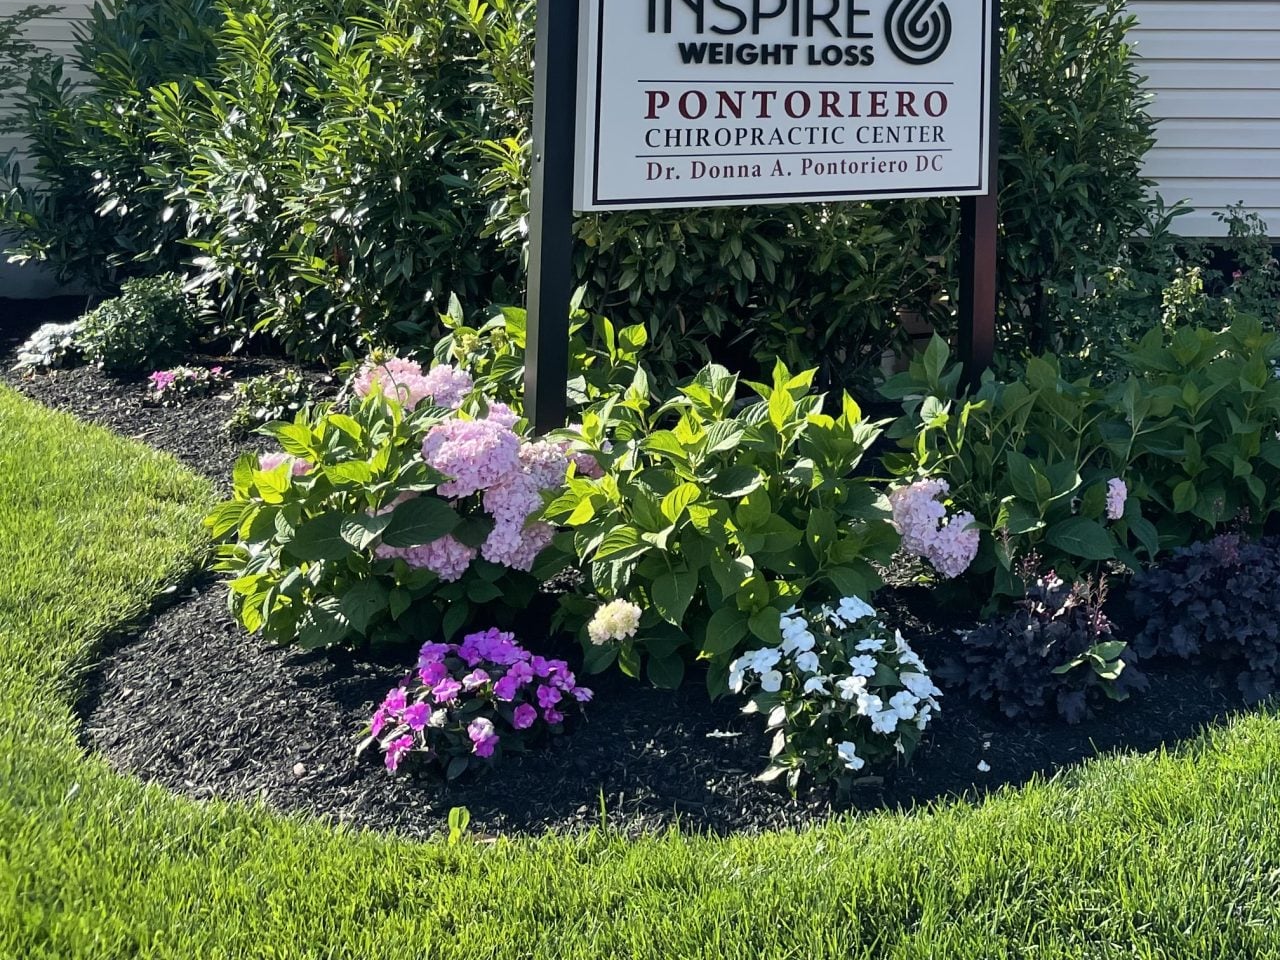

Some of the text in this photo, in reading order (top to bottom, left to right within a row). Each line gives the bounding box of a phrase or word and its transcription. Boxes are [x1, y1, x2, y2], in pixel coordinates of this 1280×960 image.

[678, 42, 874, 66] WEIGHT LOSS
[644, 90, 948, 119] PONTORIERO
[645, 125, 946, 148] CHIROPRACTIC CENTER
[646, 154, 943, 180] Dr. Donna A. Pontoriero DC
